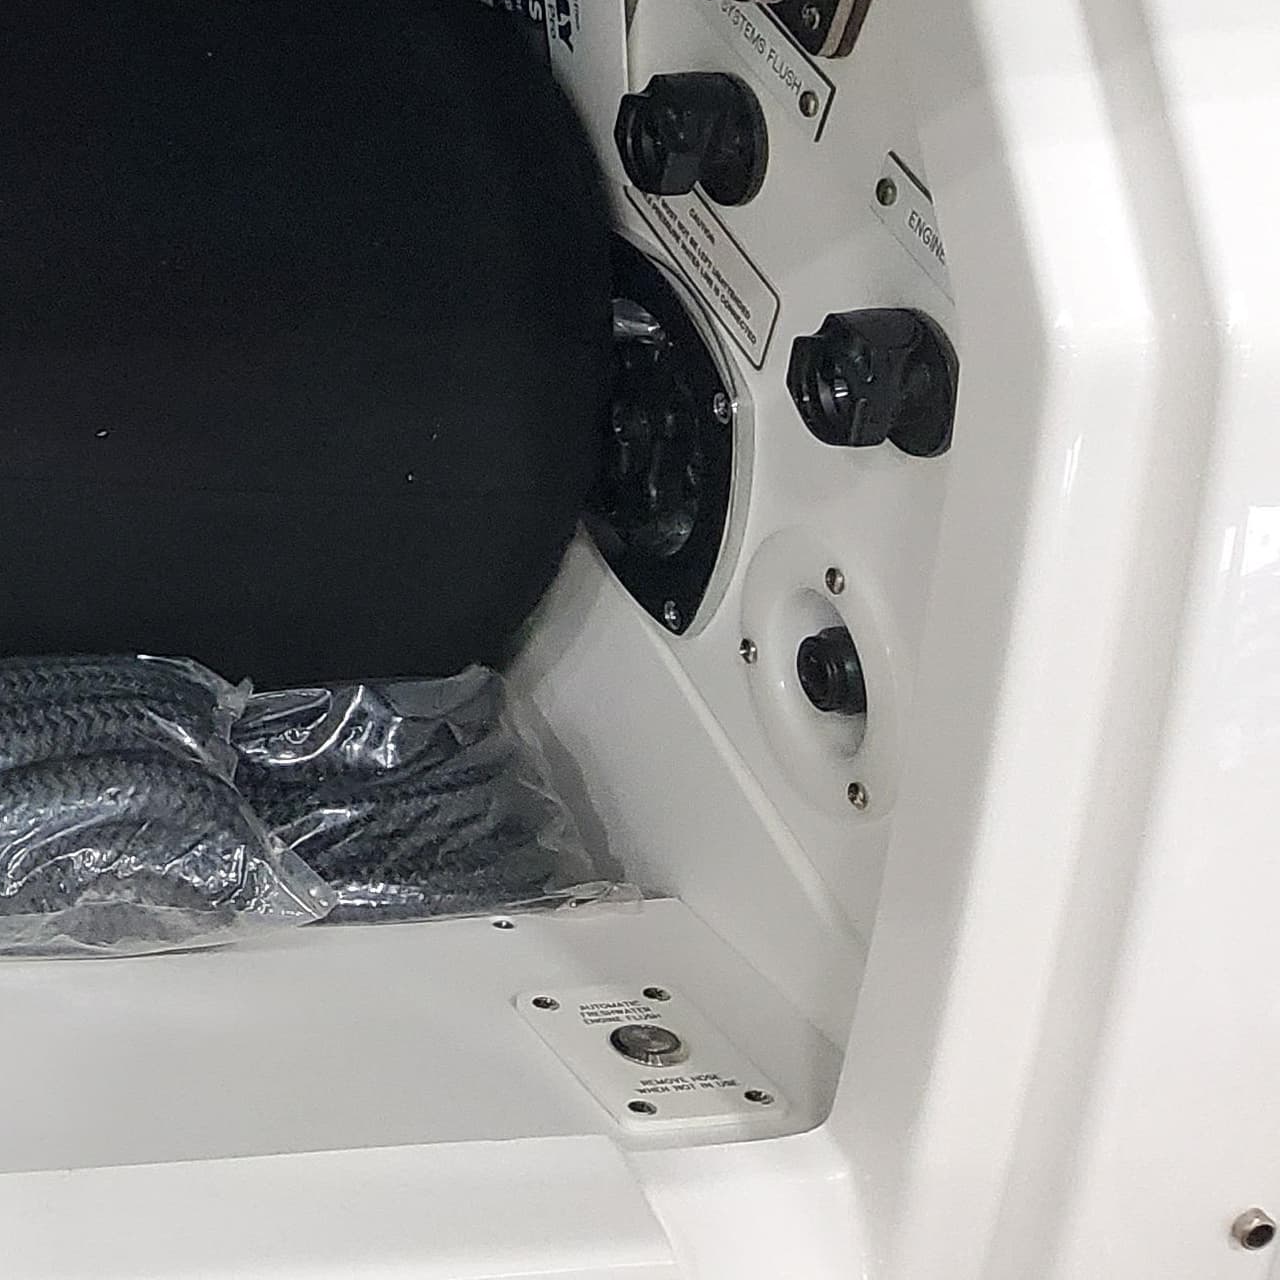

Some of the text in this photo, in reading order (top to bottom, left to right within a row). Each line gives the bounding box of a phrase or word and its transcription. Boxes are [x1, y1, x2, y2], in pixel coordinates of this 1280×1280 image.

[766, 48, 802, 96] FLUSH
[579, 999, 641, 1011] AUTOMATIC
[580, 1006, 652, 1018] FRESHWATER
[640, 1076, 686, 1086] REMOVE
